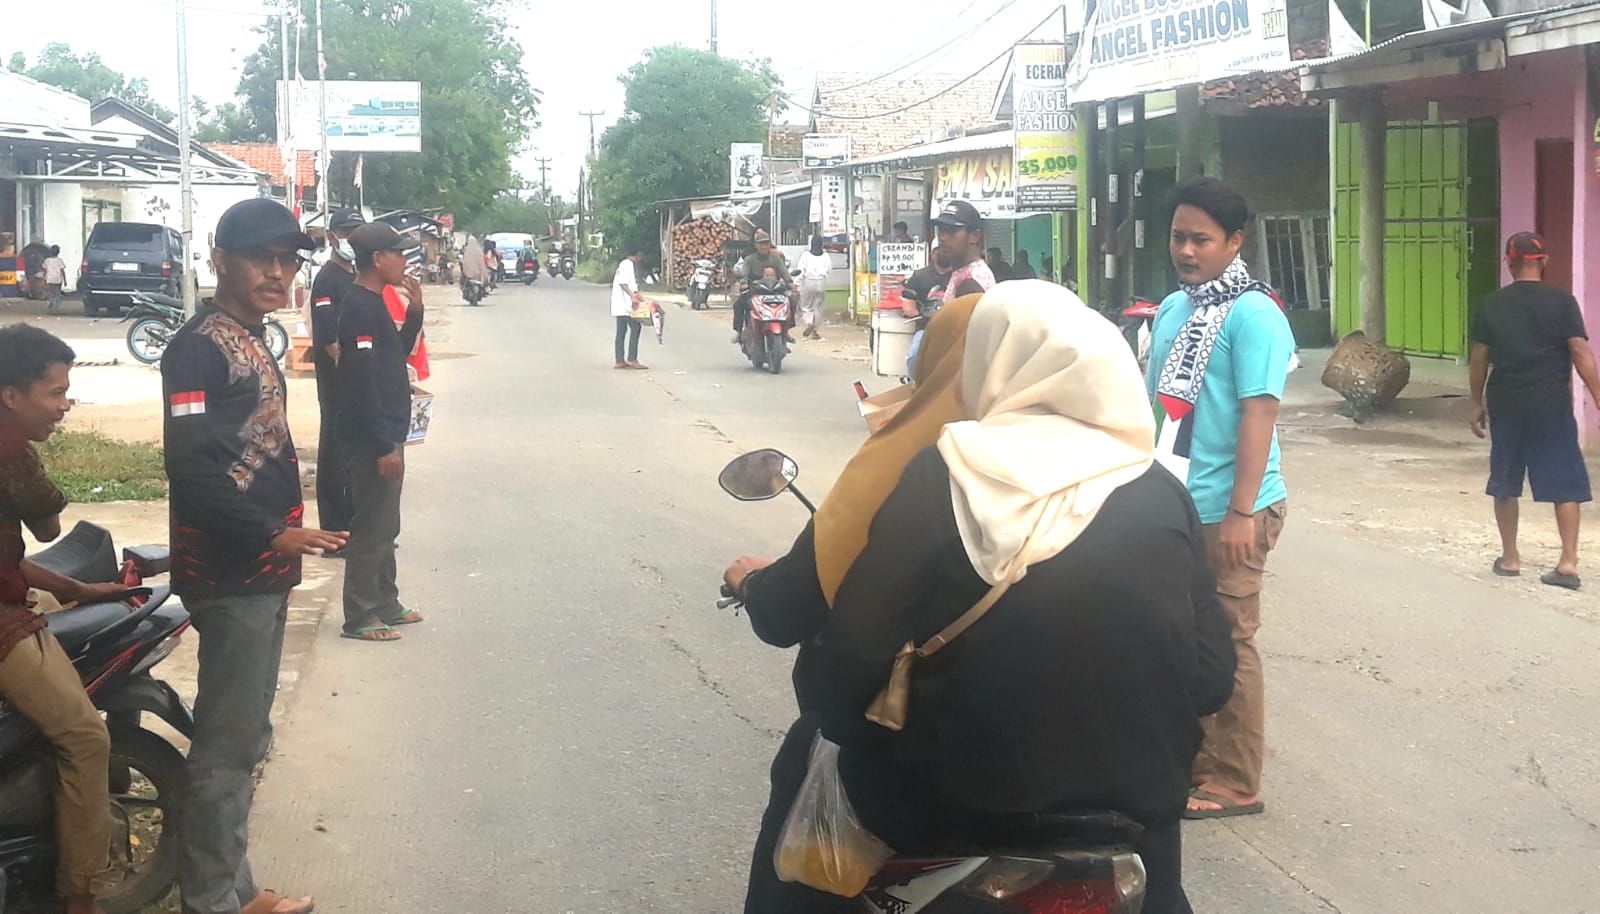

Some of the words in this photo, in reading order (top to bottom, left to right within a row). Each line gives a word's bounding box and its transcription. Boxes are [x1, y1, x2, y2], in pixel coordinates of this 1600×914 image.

[1100, 0, 1140, 24] NGEL
[1090, 24, 1147, 64] ANGEL
[1151, 0, 1250, 50] FASHION
[1016, 113, 1078, 131] FASHION
[982, 154, 1014, 192] SA
